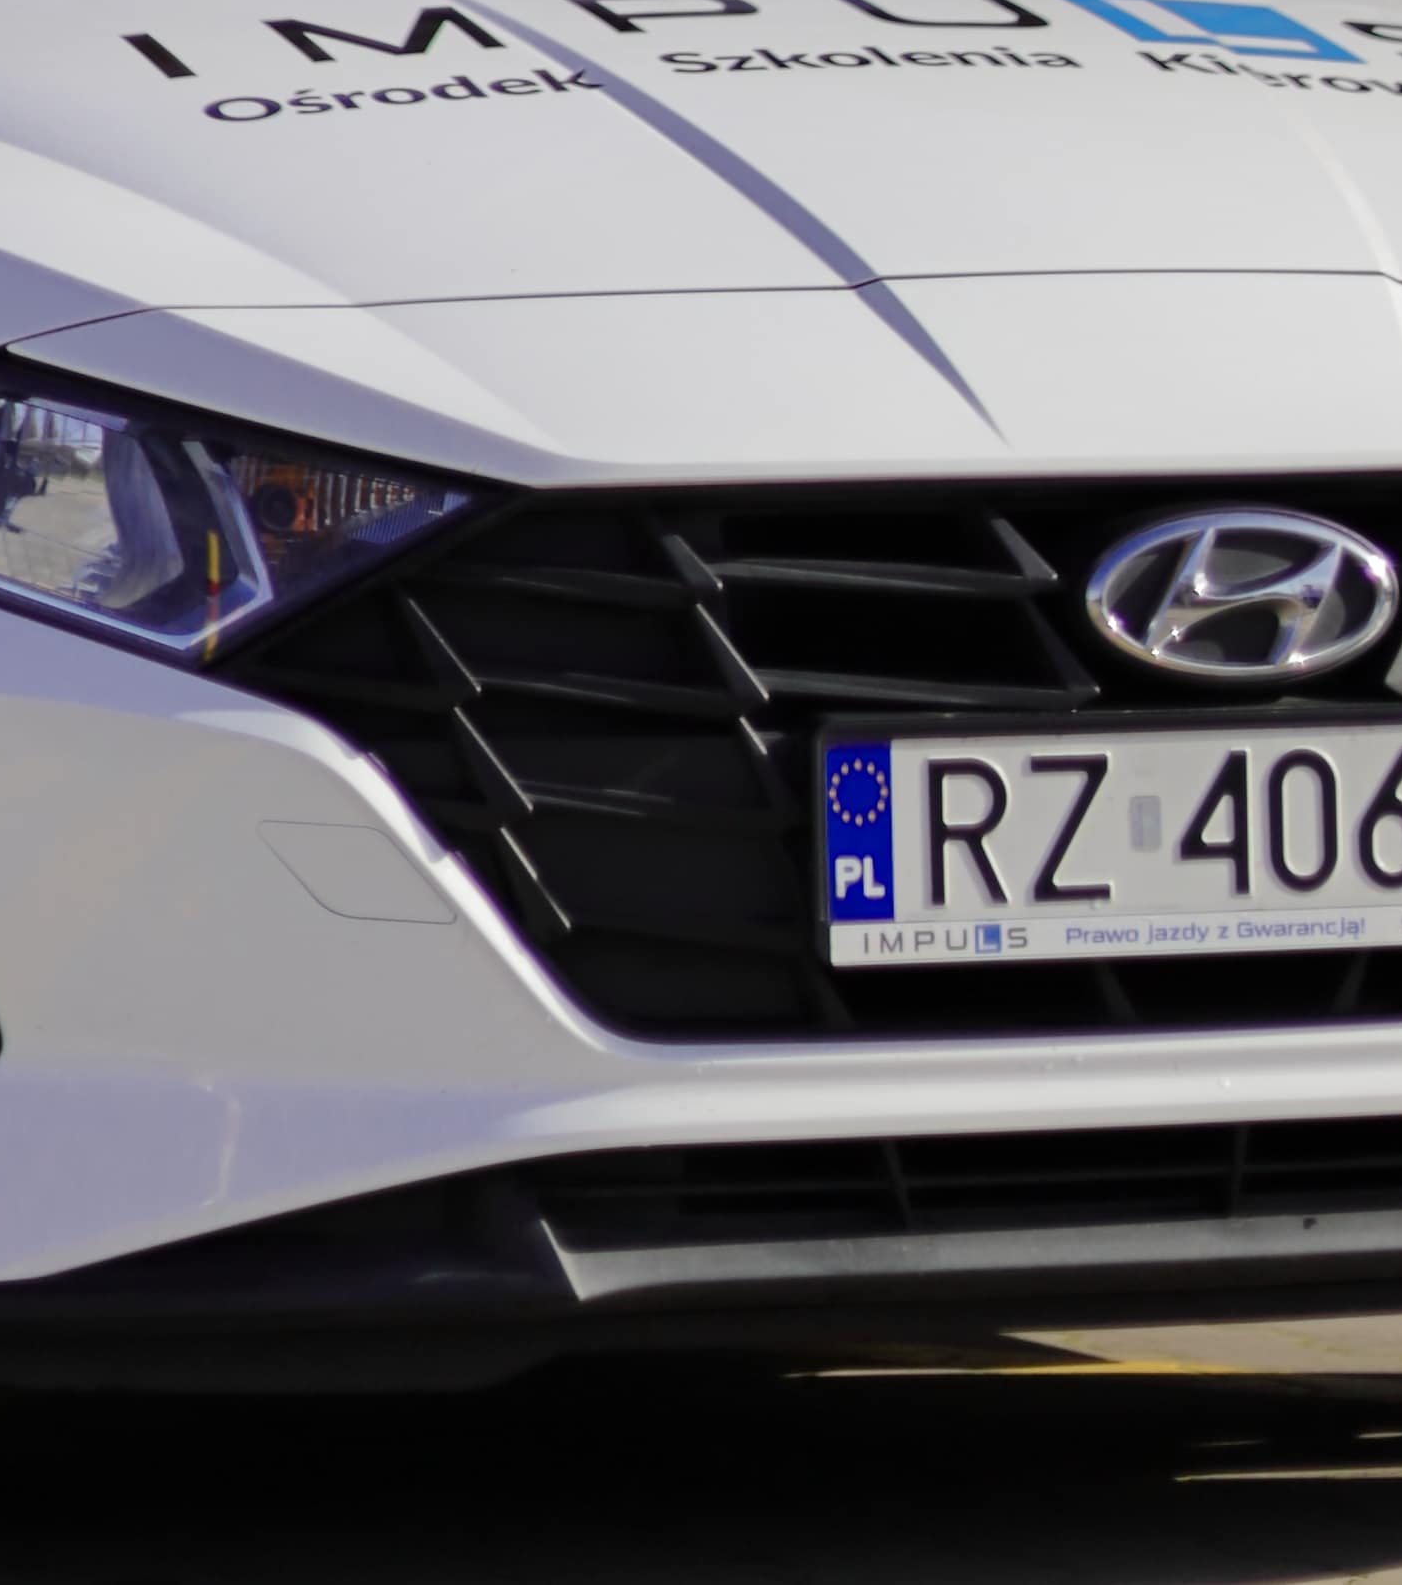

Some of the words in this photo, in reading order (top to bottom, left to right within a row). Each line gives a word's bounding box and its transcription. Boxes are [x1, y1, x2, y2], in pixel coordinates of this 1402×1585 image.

[204, 68, 604, 122] Ośrodek
[659, 46, 1083, 74] Szkolenia
[927, 752, 1112, 906] RZ
[834, 855, 886, 899] PL
[863, 925, 1029, 955] IMPULS
[1065, 926, 1140, 945] Prawo
[1217, 925, 1230, 939] z
[1237, 917, 1366, 940] Gwarancją!
